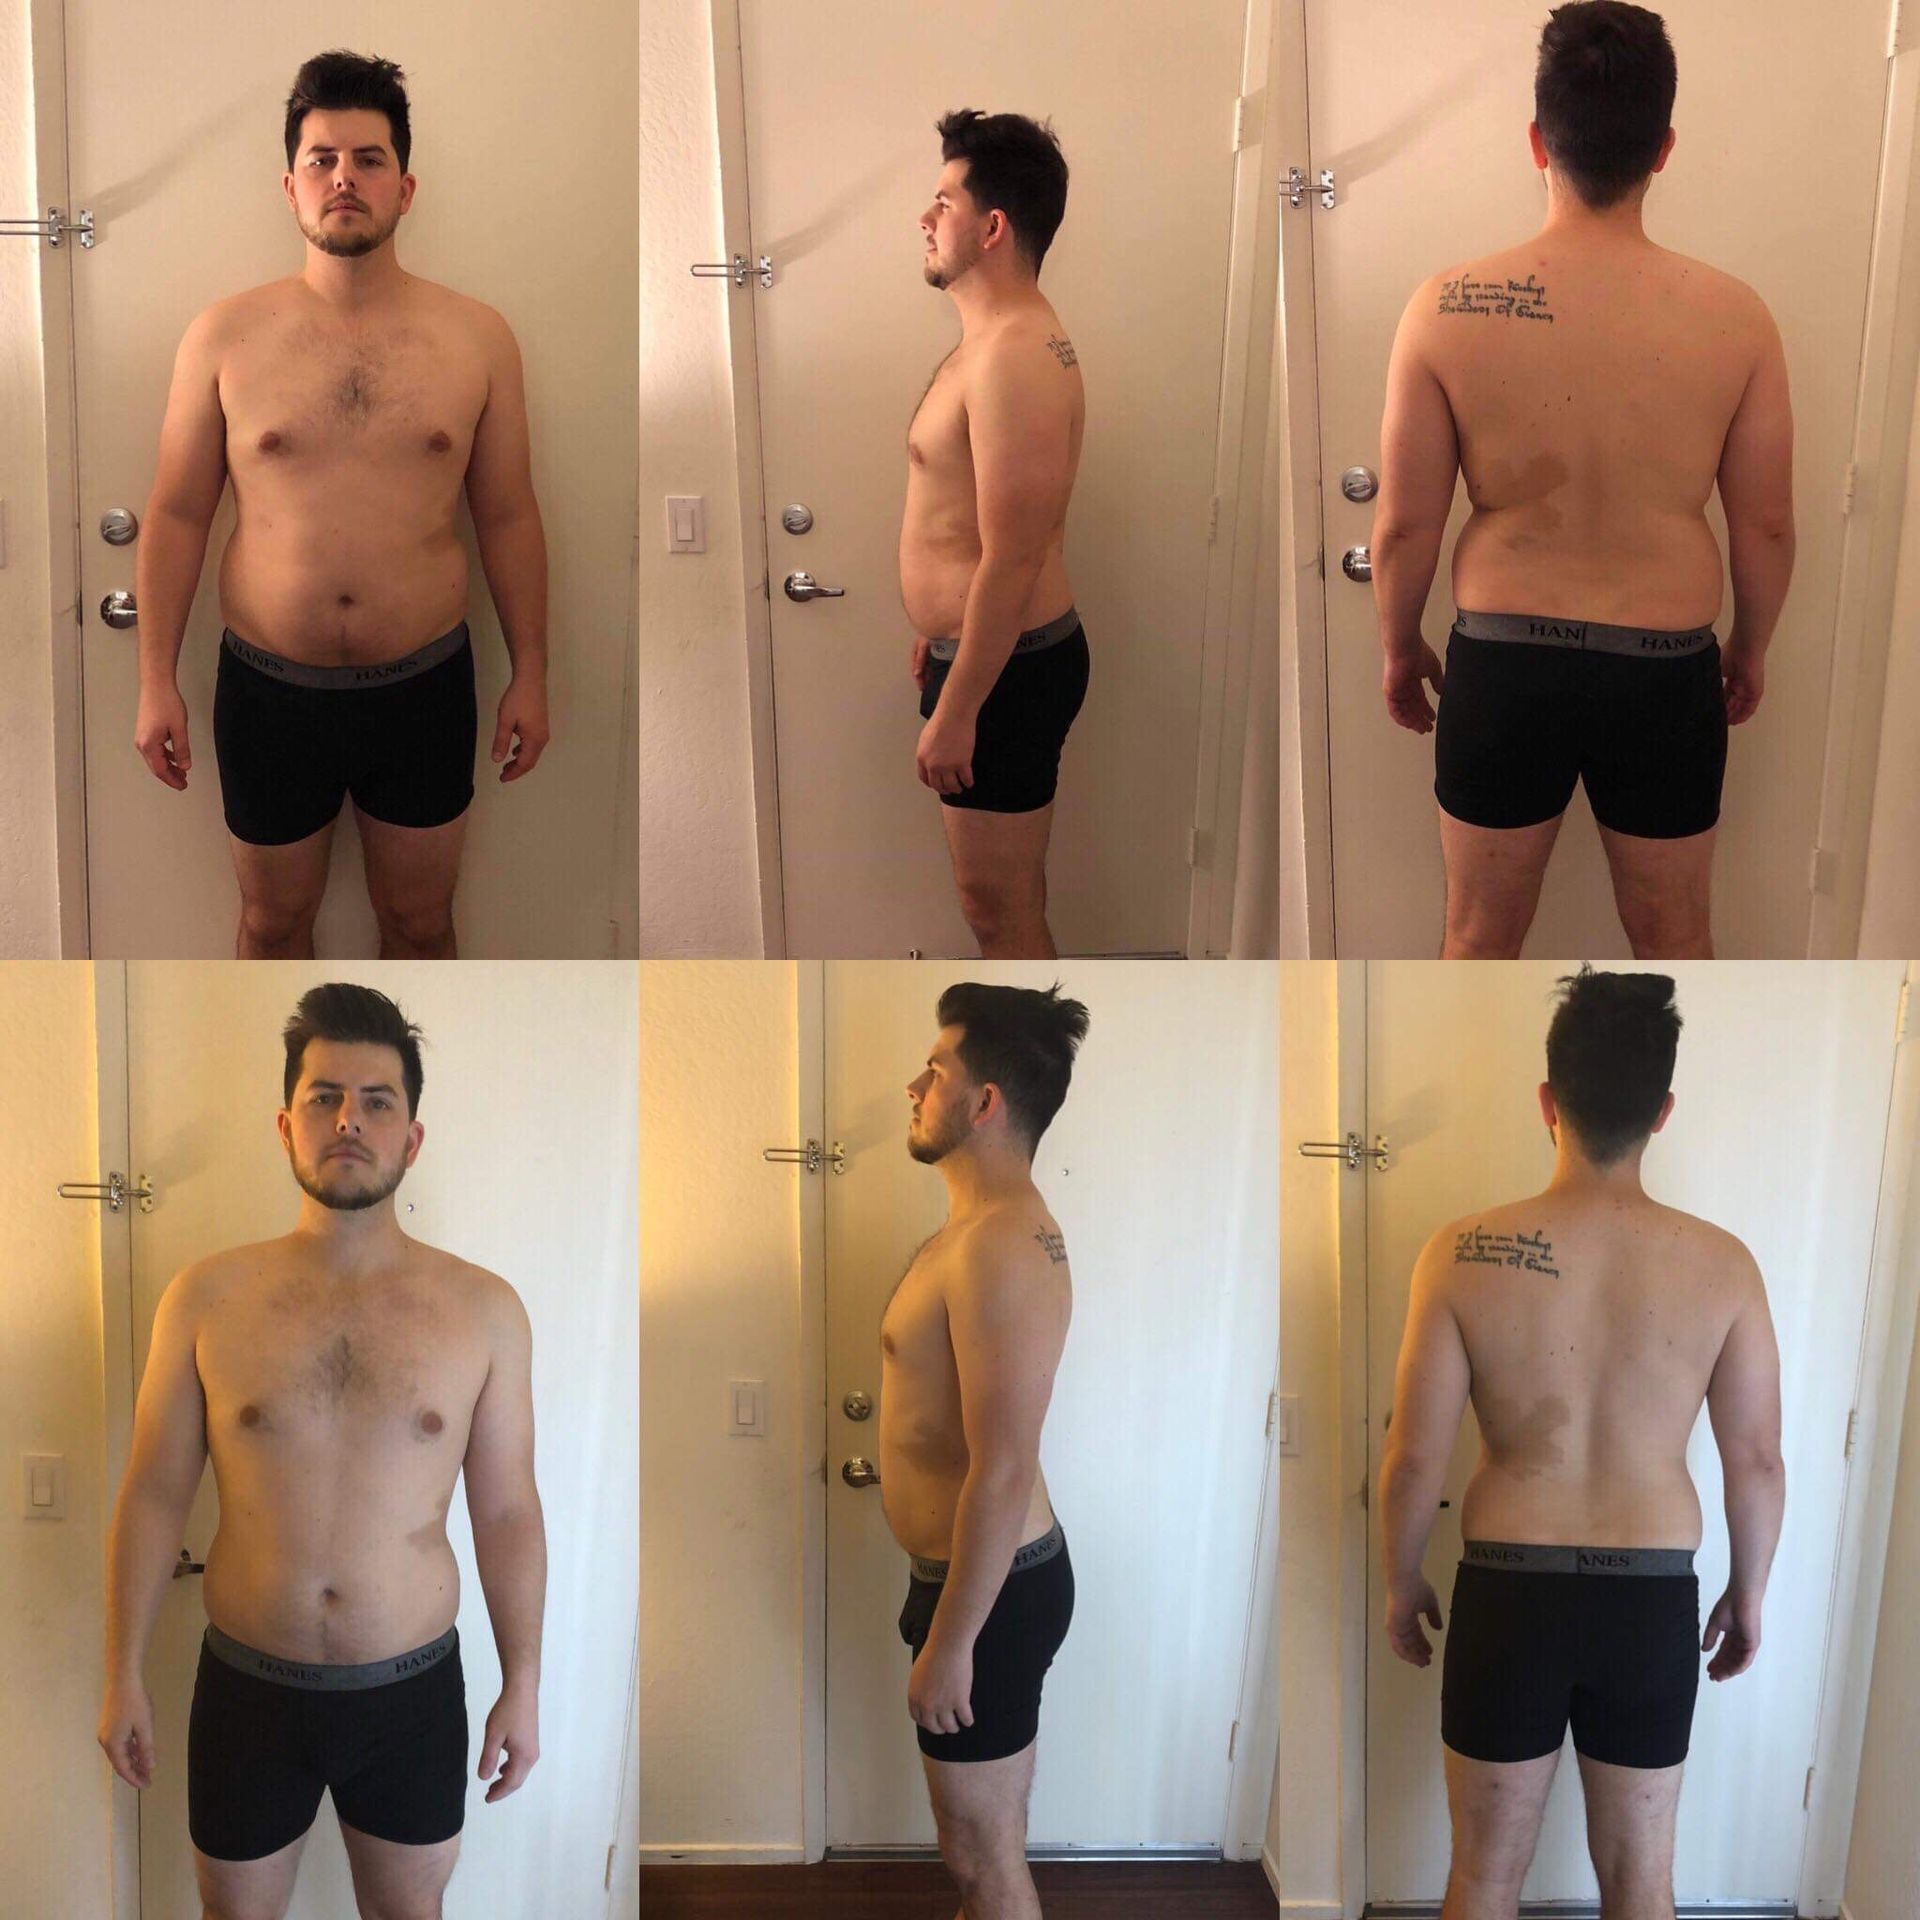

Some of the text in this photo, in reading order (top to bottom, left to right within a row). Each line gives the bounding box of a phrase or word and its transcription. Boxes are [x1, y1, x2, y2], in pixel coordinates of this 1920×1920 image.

[1016, 632, 1047, 648] NES
[1640, 634, 1704, 650] HANES
[232, 641, 418, 681] HANES HANES
[915, 1536, 1057, 1578] HANES HANES
[1470, 1547, 1525, 1563] HANES
[258, 1644, 447, 1681] HANES HANES
